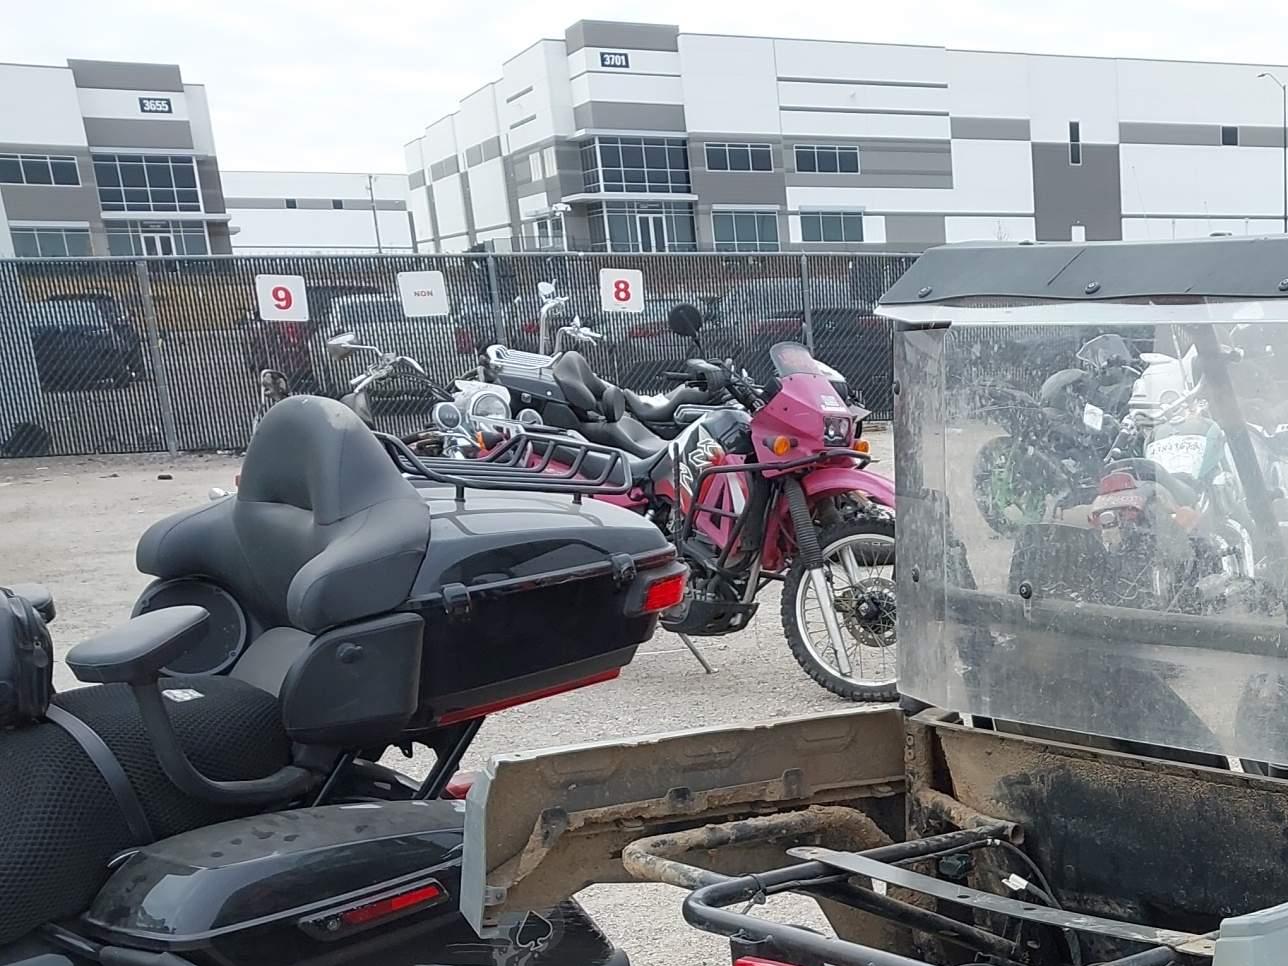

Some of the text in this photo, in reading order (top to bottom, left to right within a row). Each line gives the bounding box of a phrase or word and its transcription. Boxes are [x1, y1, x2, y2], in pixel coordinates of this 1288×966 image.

[603, 54, 627, 66] 3701
[142, 100, 169, 111] 3655
[271, 286, 293, 311] 9
[614, 280, 631, 301] 8
